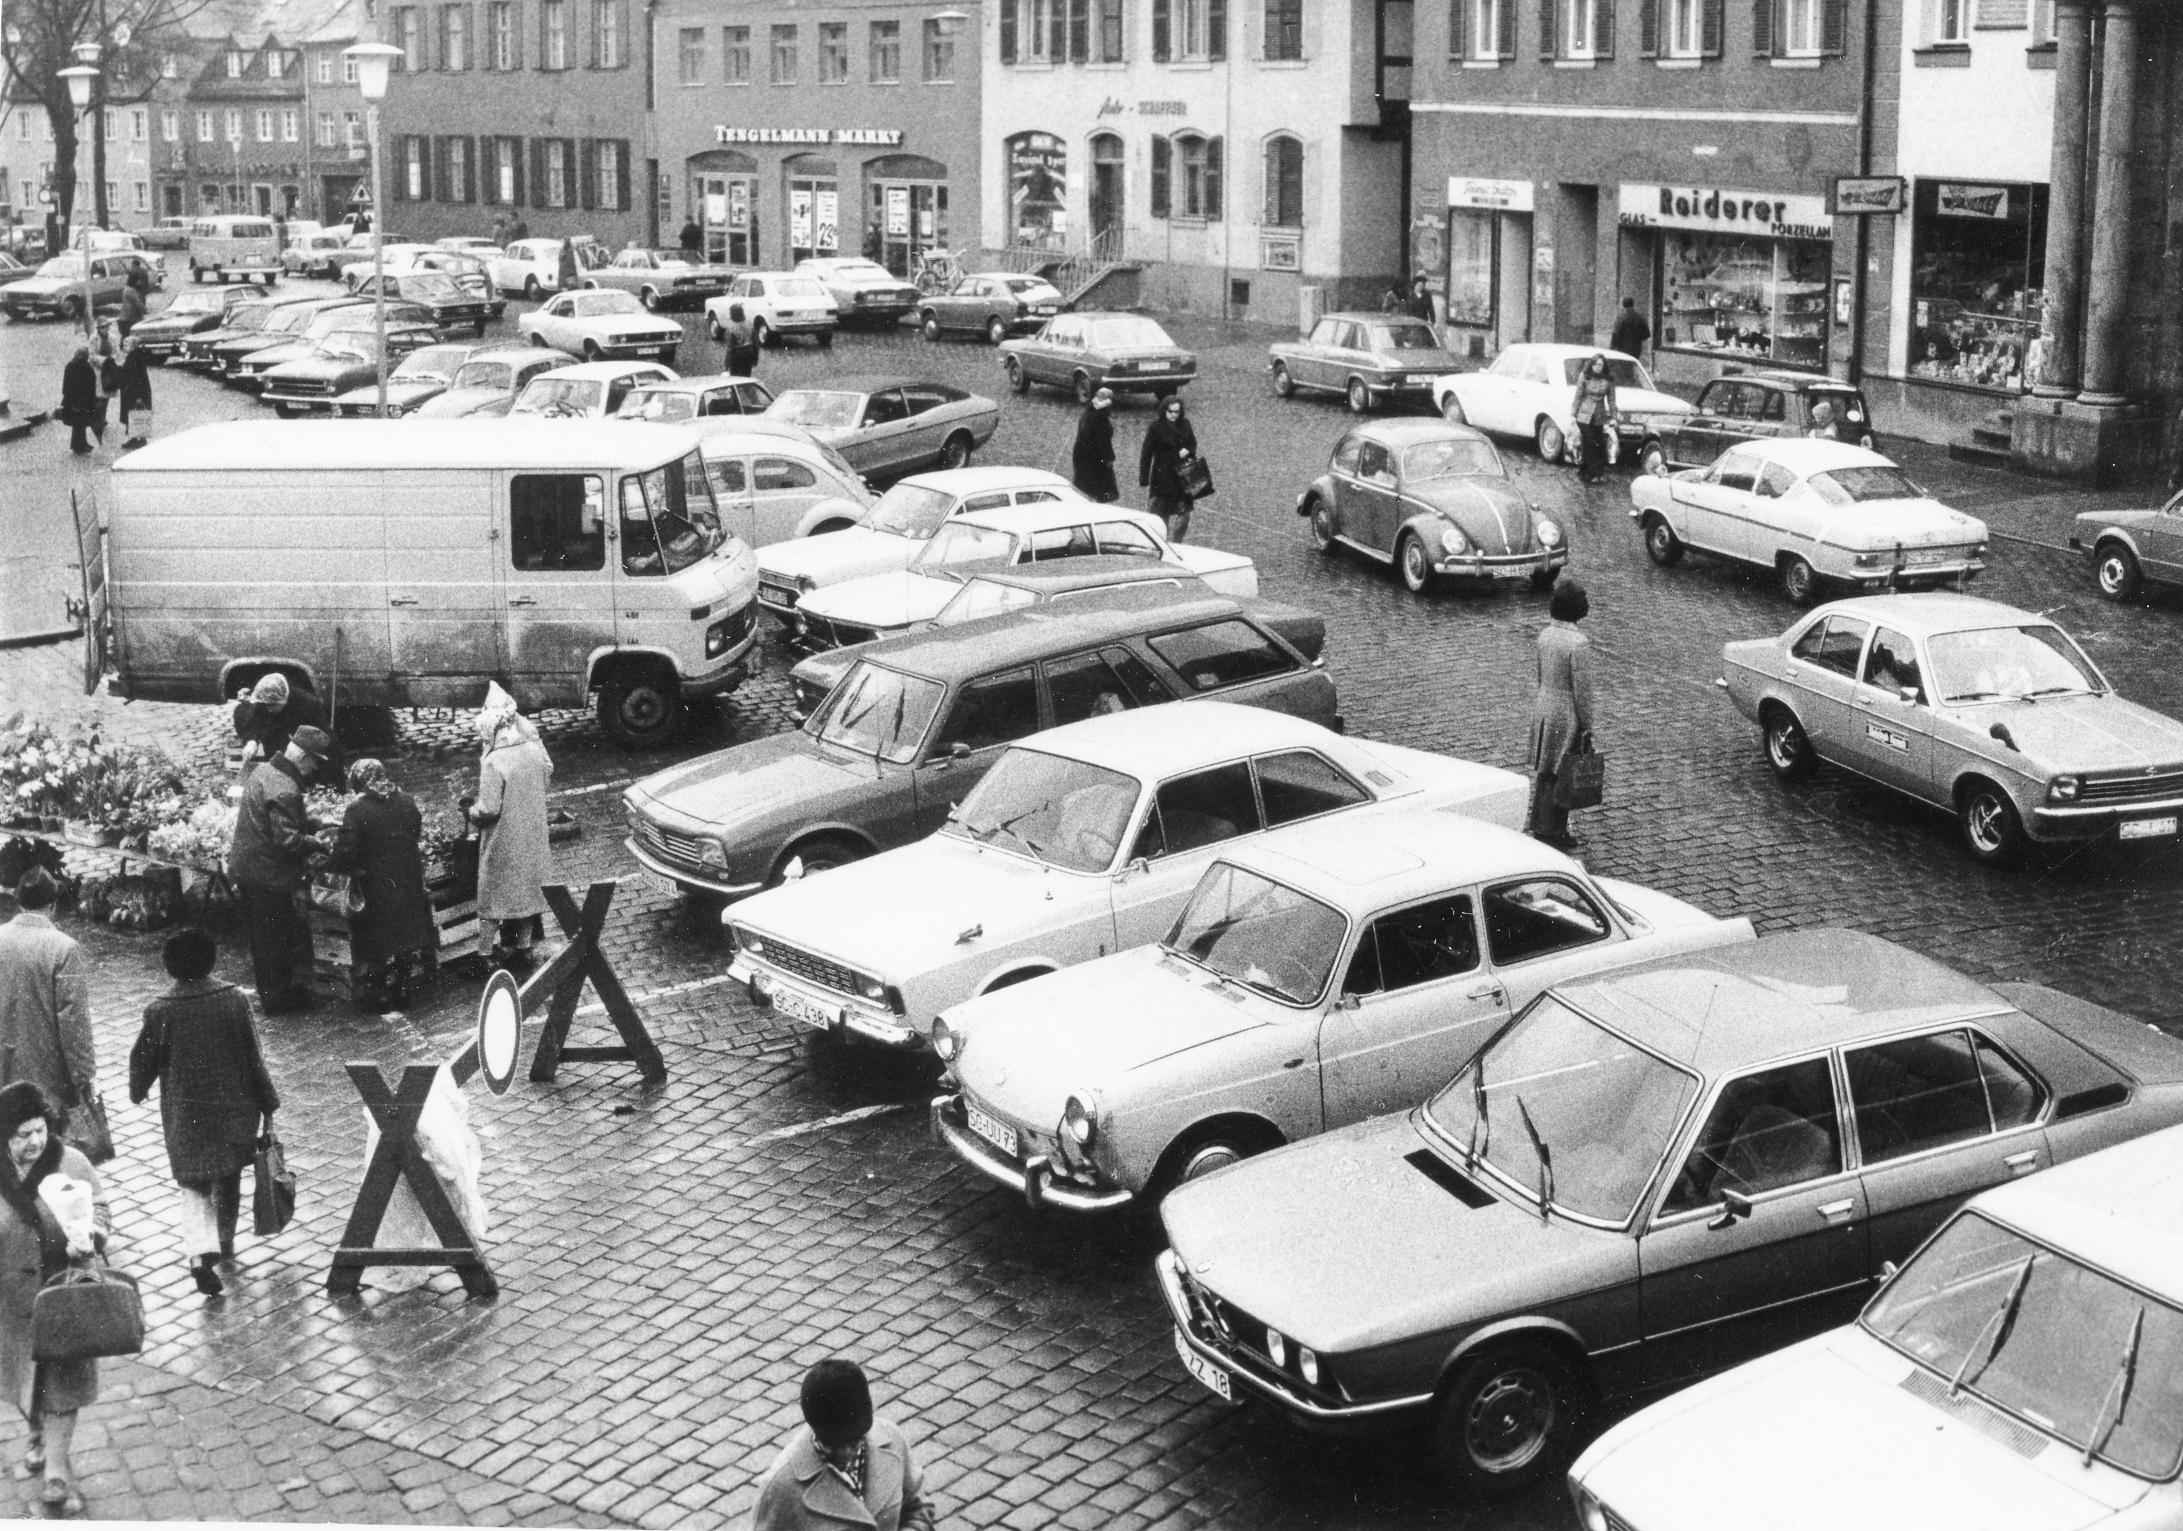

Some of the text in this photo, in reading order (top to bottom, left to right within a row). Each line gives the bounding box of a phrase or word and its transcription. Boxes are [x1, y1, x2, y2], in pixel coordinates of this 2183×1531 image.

[714, 125, 902, 144] TENGELMANN MARKT
[1659, 187, 1786, 222] Reiderer
[1619, 212, 1645, 226] GLAS
[1771, 223, 1831, 238] PORZELLAN
[1004, 1131, 1017, 1153] 73
[1212, 1369, 1228, 1394] 18
